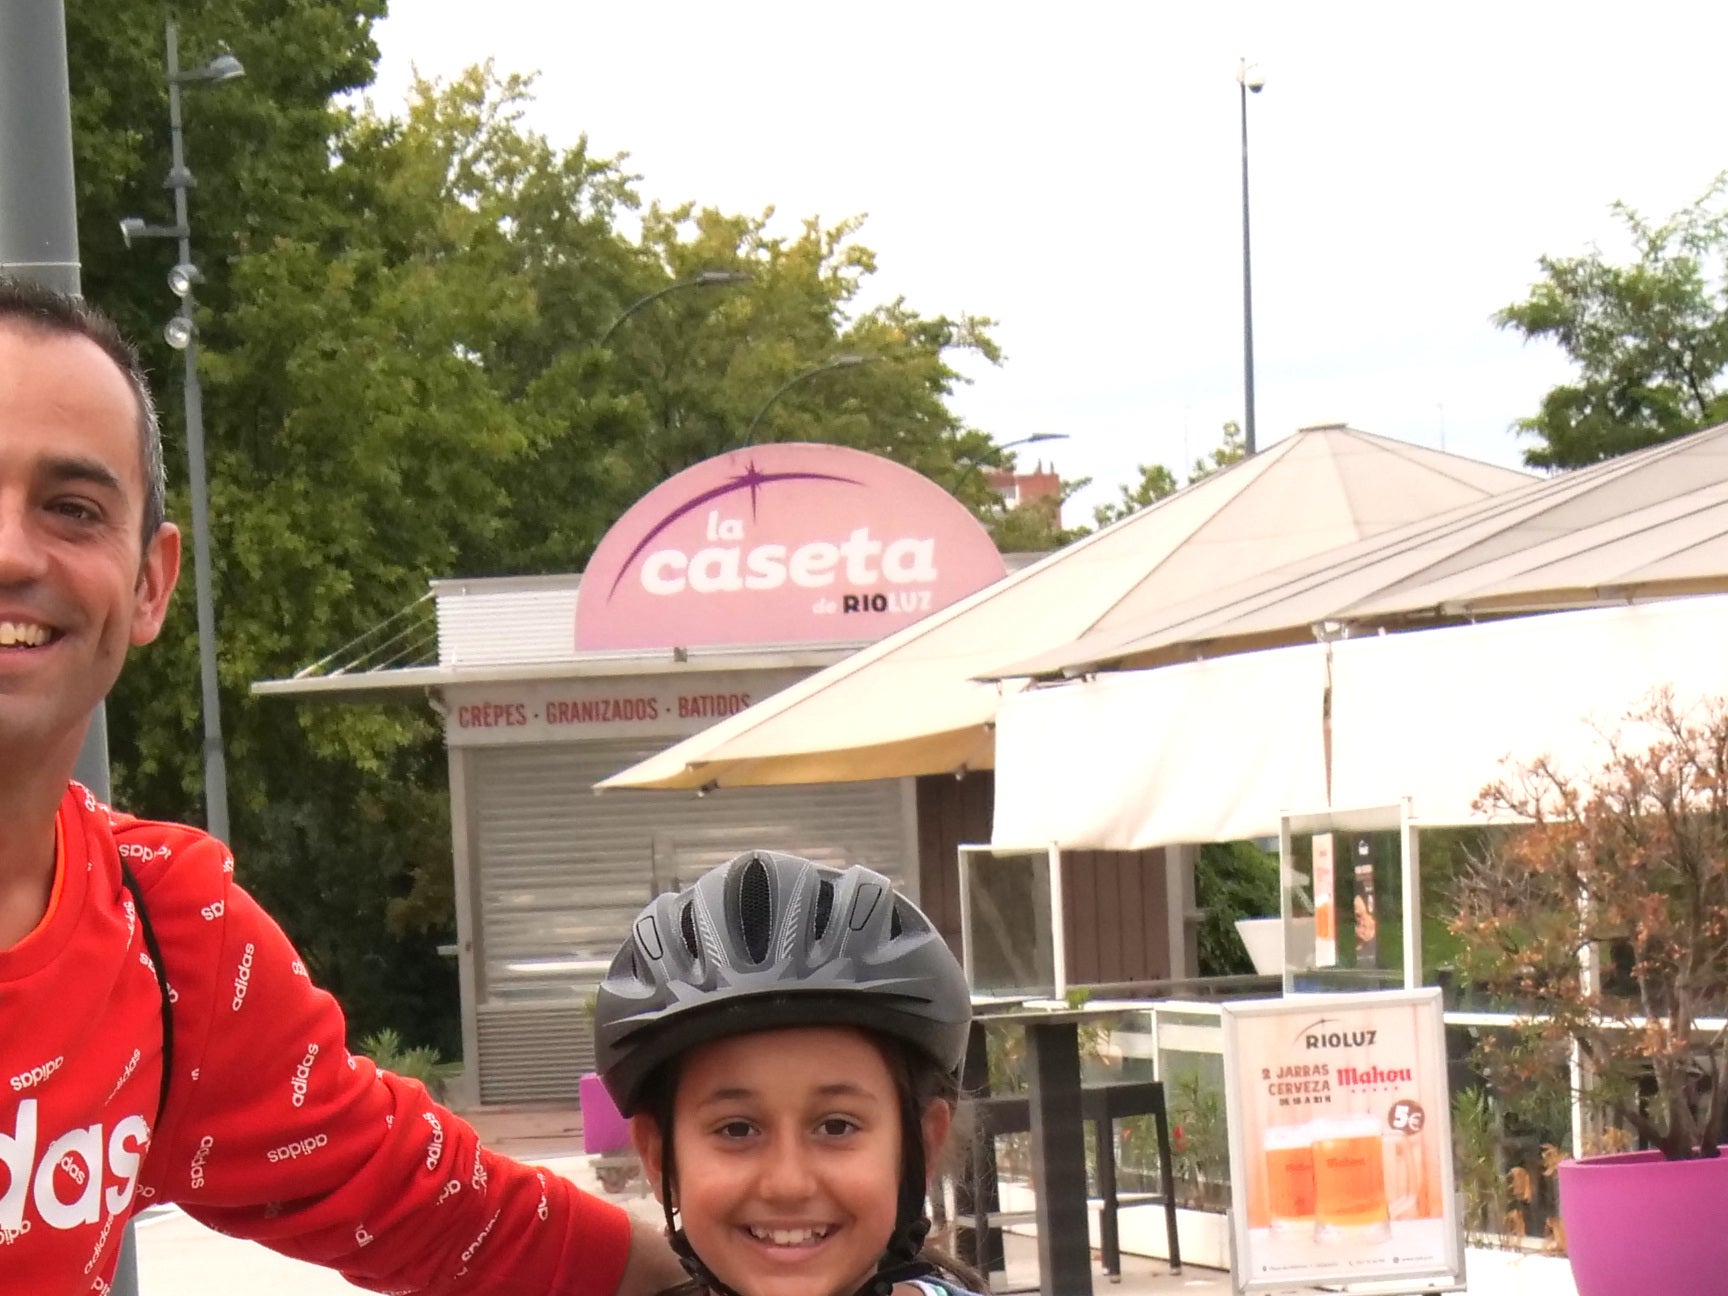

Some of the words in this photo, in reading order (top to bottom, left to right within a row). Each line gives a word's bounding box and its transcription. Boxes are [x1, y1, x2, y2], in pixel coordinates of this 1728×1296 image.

[707, 510, 744, 541] la
[641, 527, 938, 597] caseta
[811, 598, 838, 615] de
[843, 591, 932, 615] RIOLUZ
[458, 700, 527, 729] CRÊPES
[546, 698, 659, 726] GRANIZADOS
[678, 692, 752, 720] BATIDOS
[232, 942, 255, 1012] adidas
[1306, 1030, 1377, 1050] RIOLUZ
[10, 1055, 64, 1092] adidas
[292, 1042, 320, 1108] adidas
[1276, 1063, 1330, 1079] JARRAS
[1337, 1065, 1412, 1087] Mahou
[1268, 1080, 1331, 1096] CERVEZA
[266, 1134, 328, 1163] adidas
